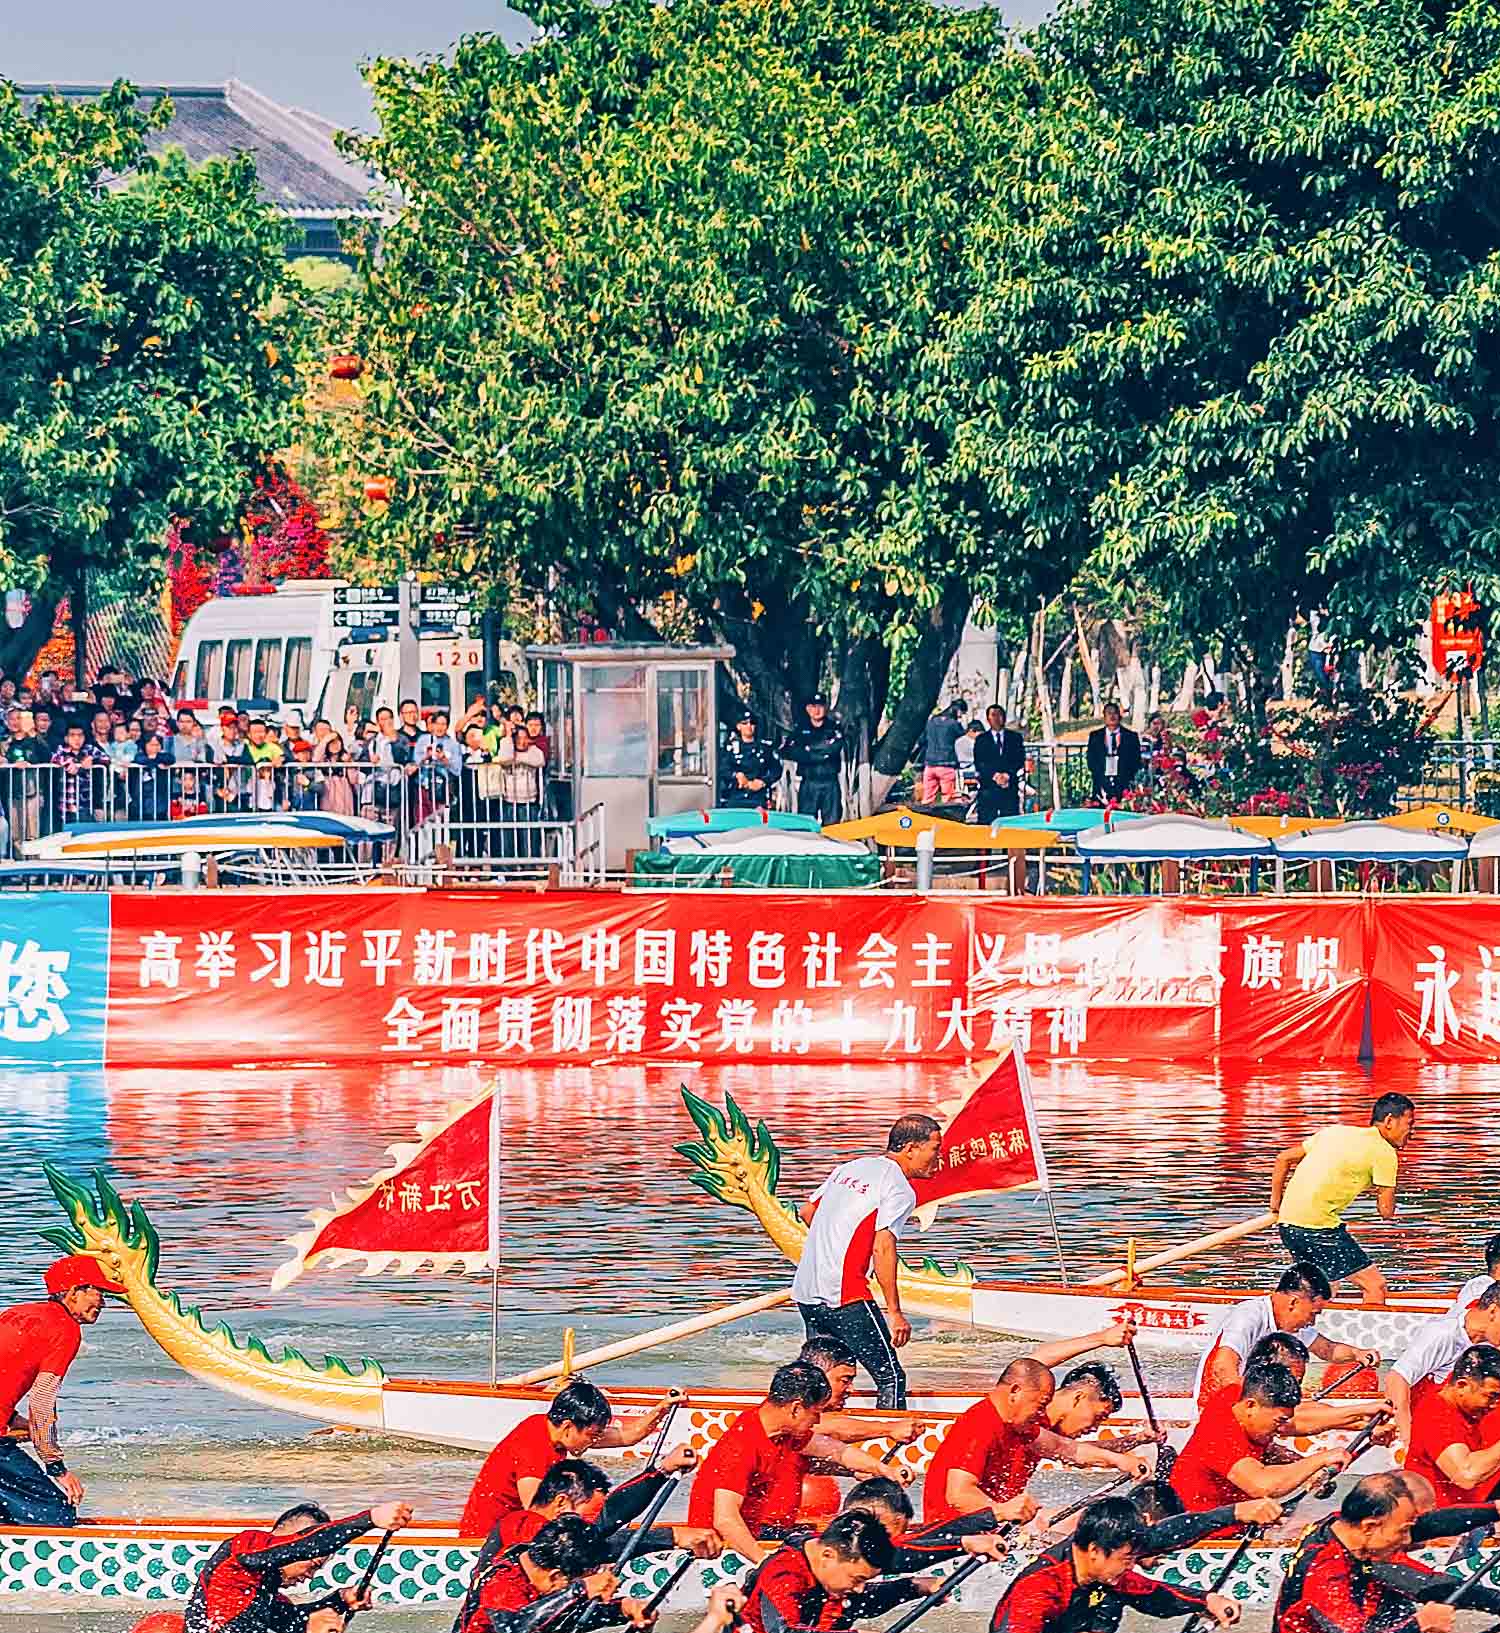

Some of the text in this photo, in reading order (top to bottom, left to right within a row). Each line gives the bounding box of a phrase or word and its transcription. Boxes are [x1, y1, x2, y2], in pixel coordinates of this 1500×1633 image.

[435, 651, 479, 666] 120
[138, 928, 1342, 991] 高举习近平新时代中国特色社会主义思大旗帜
[381, 996, 1089, 1057] 全面贯彻落实党的十九大精神
